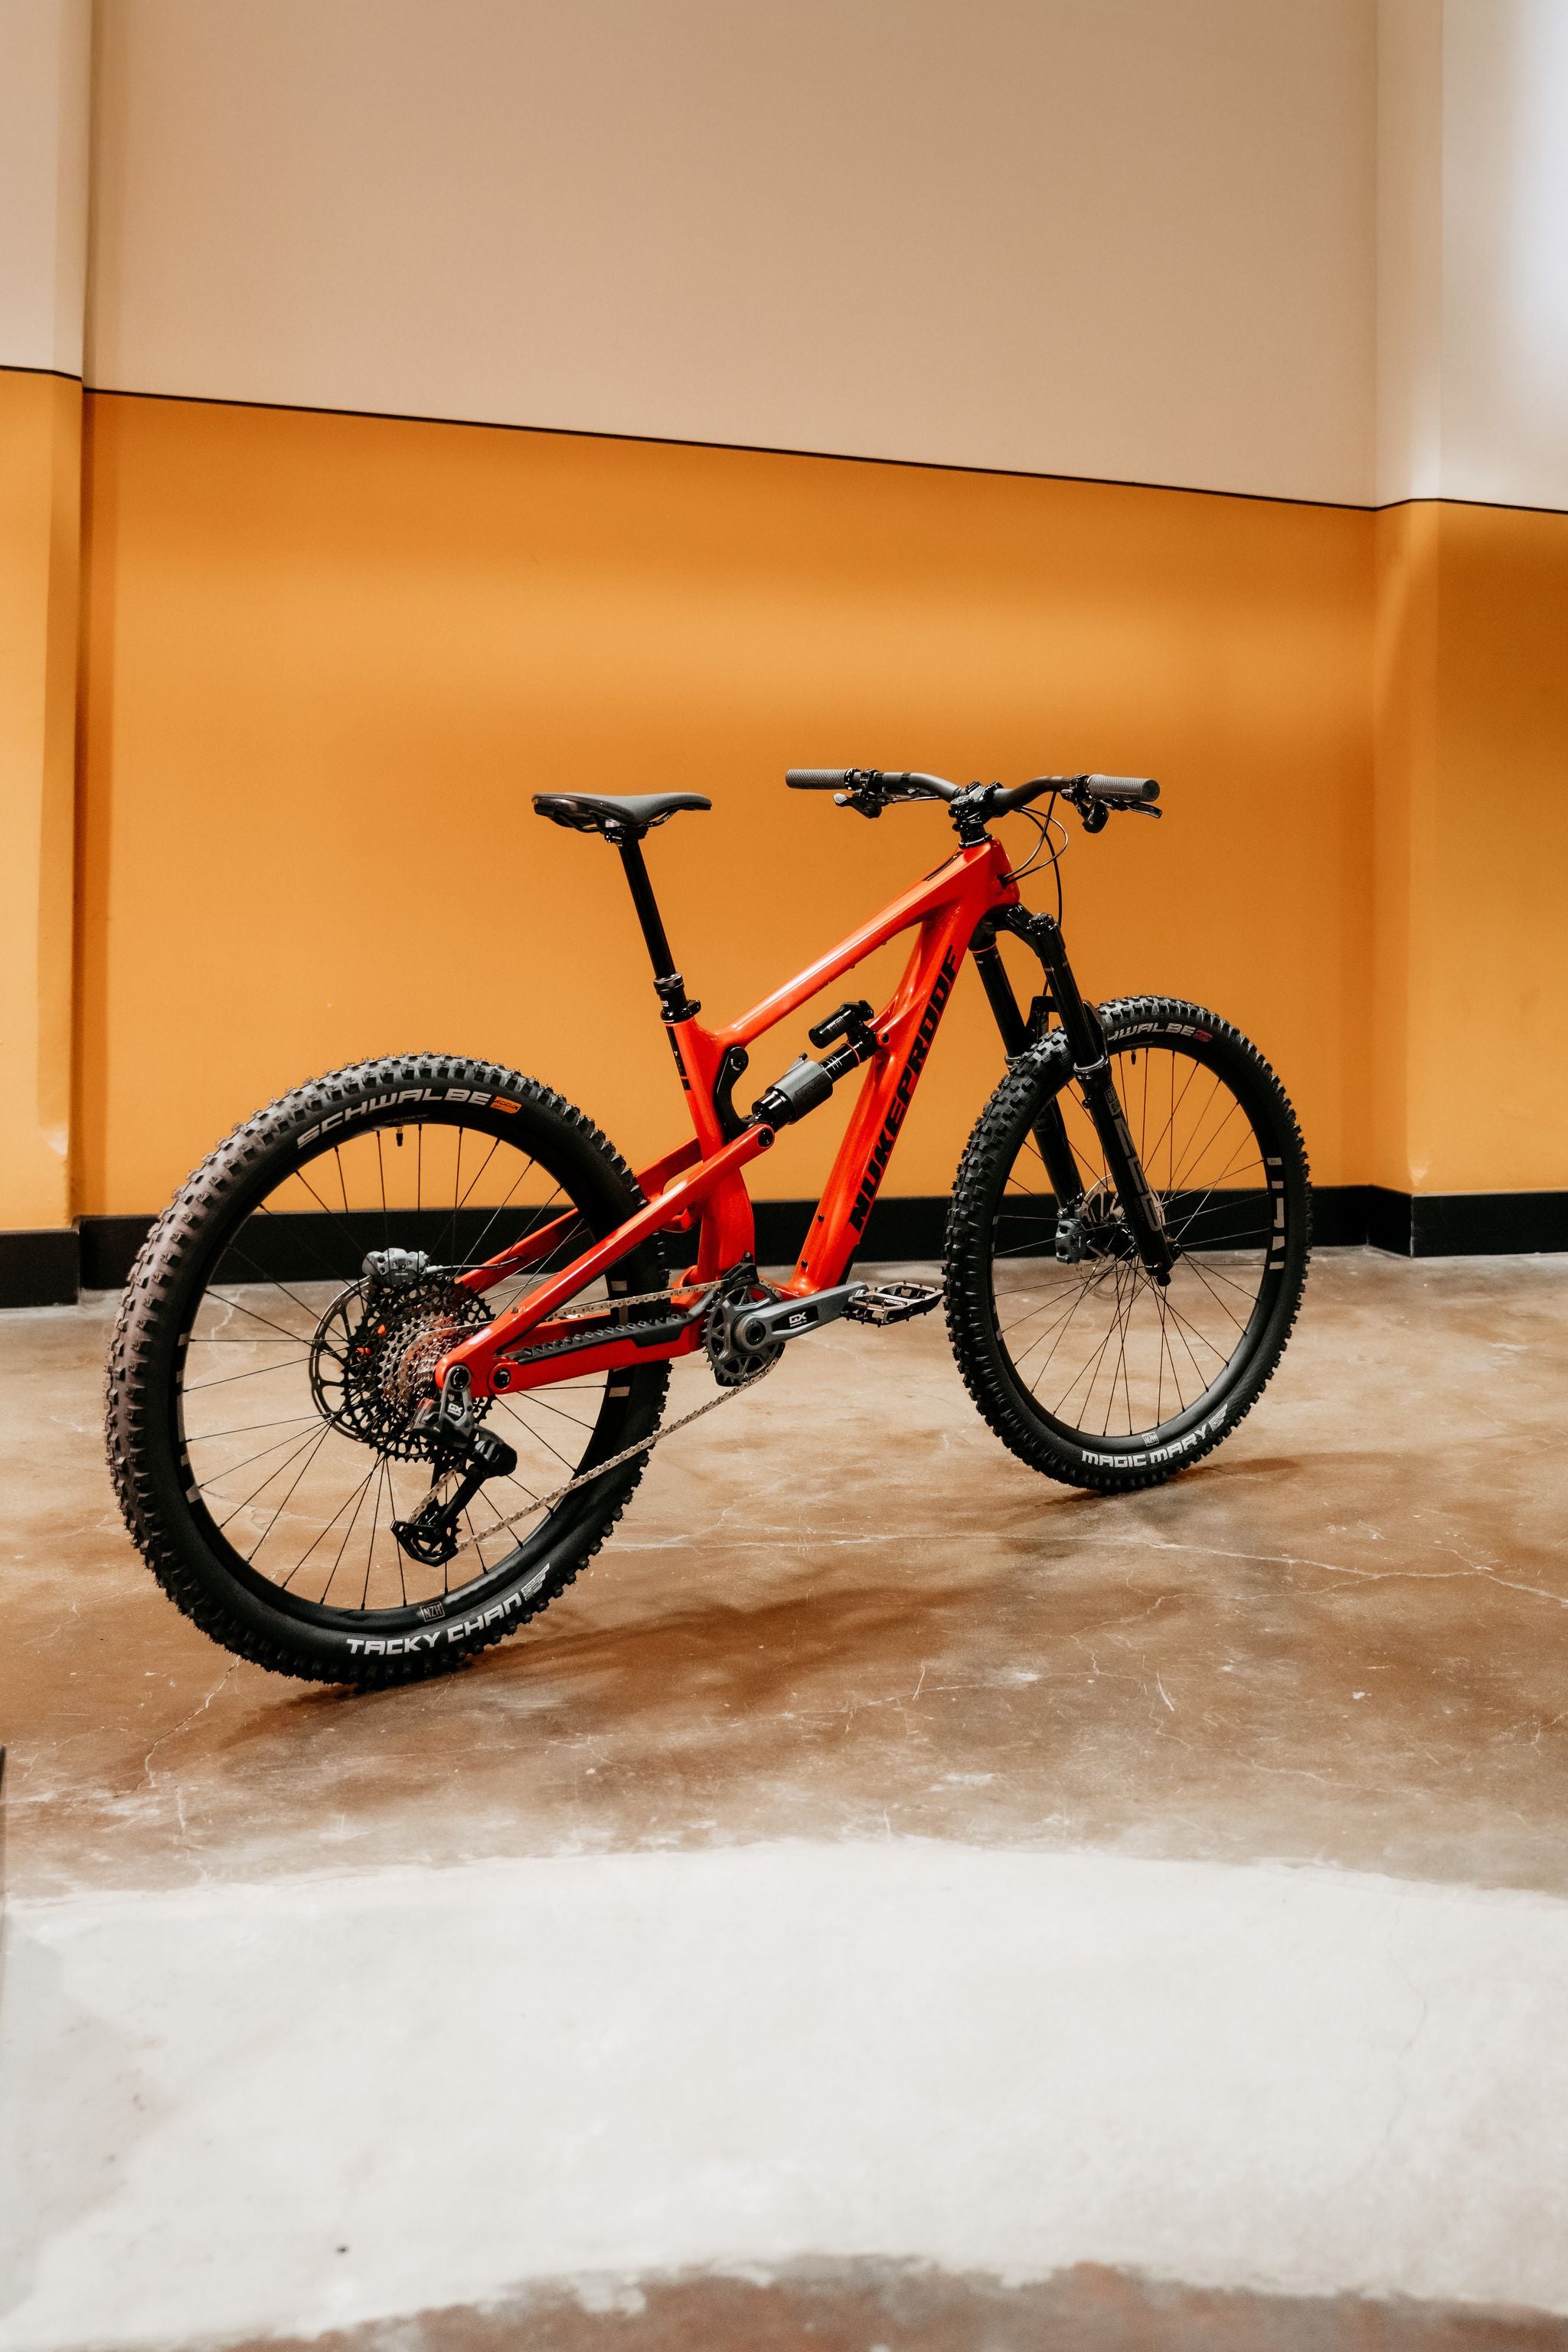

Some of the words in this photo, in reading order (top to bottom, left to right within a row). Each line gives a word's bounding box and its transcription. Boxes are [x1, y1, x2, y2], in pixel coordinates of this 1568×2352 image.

[1106, 1022, 1197, 1041] HWALBE
[297, 1088, 492, 1149] SCHWALBE
[841, 944, 957, 1233] NUKEPROOF
[1082, 1450, 1147, 1468] MAGIC
[1150, 1423, 1207, 1465] MARY
[347, 1632, 441, 1655] TACKY
[447, 1592, 522, 1644] CHAN
